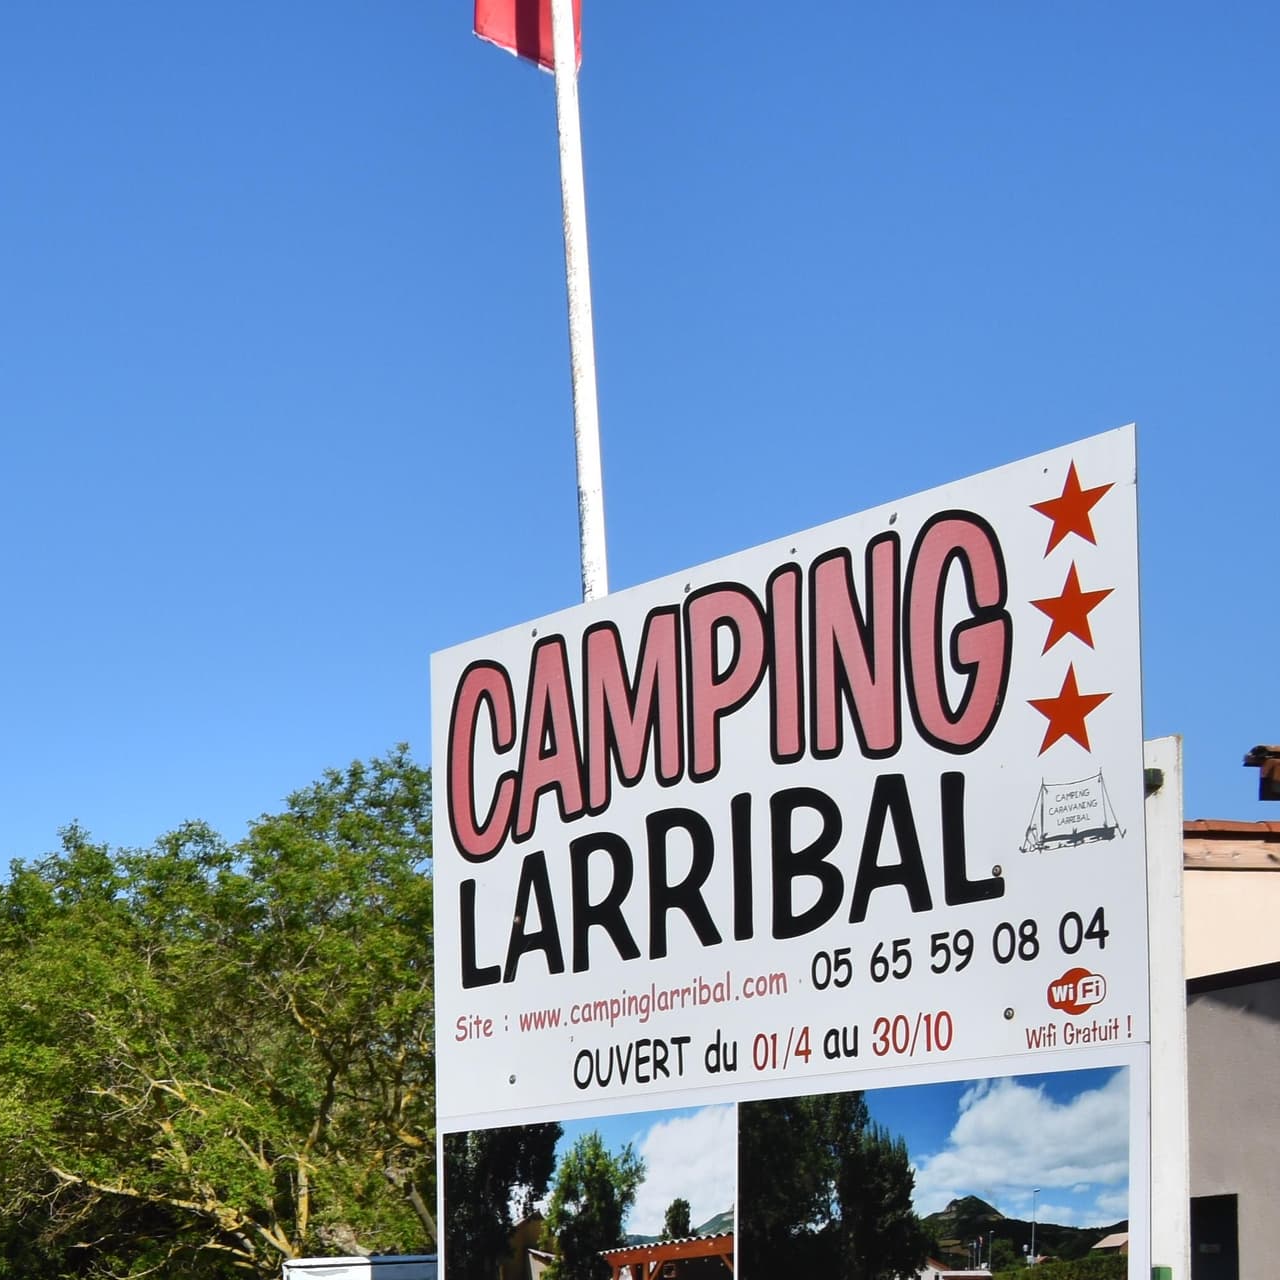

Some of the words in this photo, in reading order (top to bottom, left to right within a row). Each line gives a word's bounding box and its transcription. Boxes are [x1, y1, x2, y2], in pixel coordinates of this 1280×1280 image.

[447, 509, 1012, 864] CAMPING
[1049, 799, 1097, 815] CARAVANING
[1056, 789, 1090, 802] CAMPING
[1057, 813, 1090, 825] LARRIBAL
[460, 772, 1005, 988] LARRIBAL
[811, 947, 853, 990] 05
[870, 938, 912, 983] 65
[930, 929, 974, 974] 59
[993, 919, 1039, 964] 08
[1059, 906, 1109, 955] 04
[455, 1016, 493, 1041] Site
[520, 971, 787, 1032] www.campinglarribal.com
[1026, 1023, 1056, 1049] Wifi
[1064, 1017, 1119, 1045] Gratuit
[573, 1035, 691, 1090] OUVERT
[704, 1028, 738, 1073] du
[752, 1026, 812, 1070] 01/4
[823, 1024, 859, 1060] au
[872, 1010, 953, 1057] 30/10
